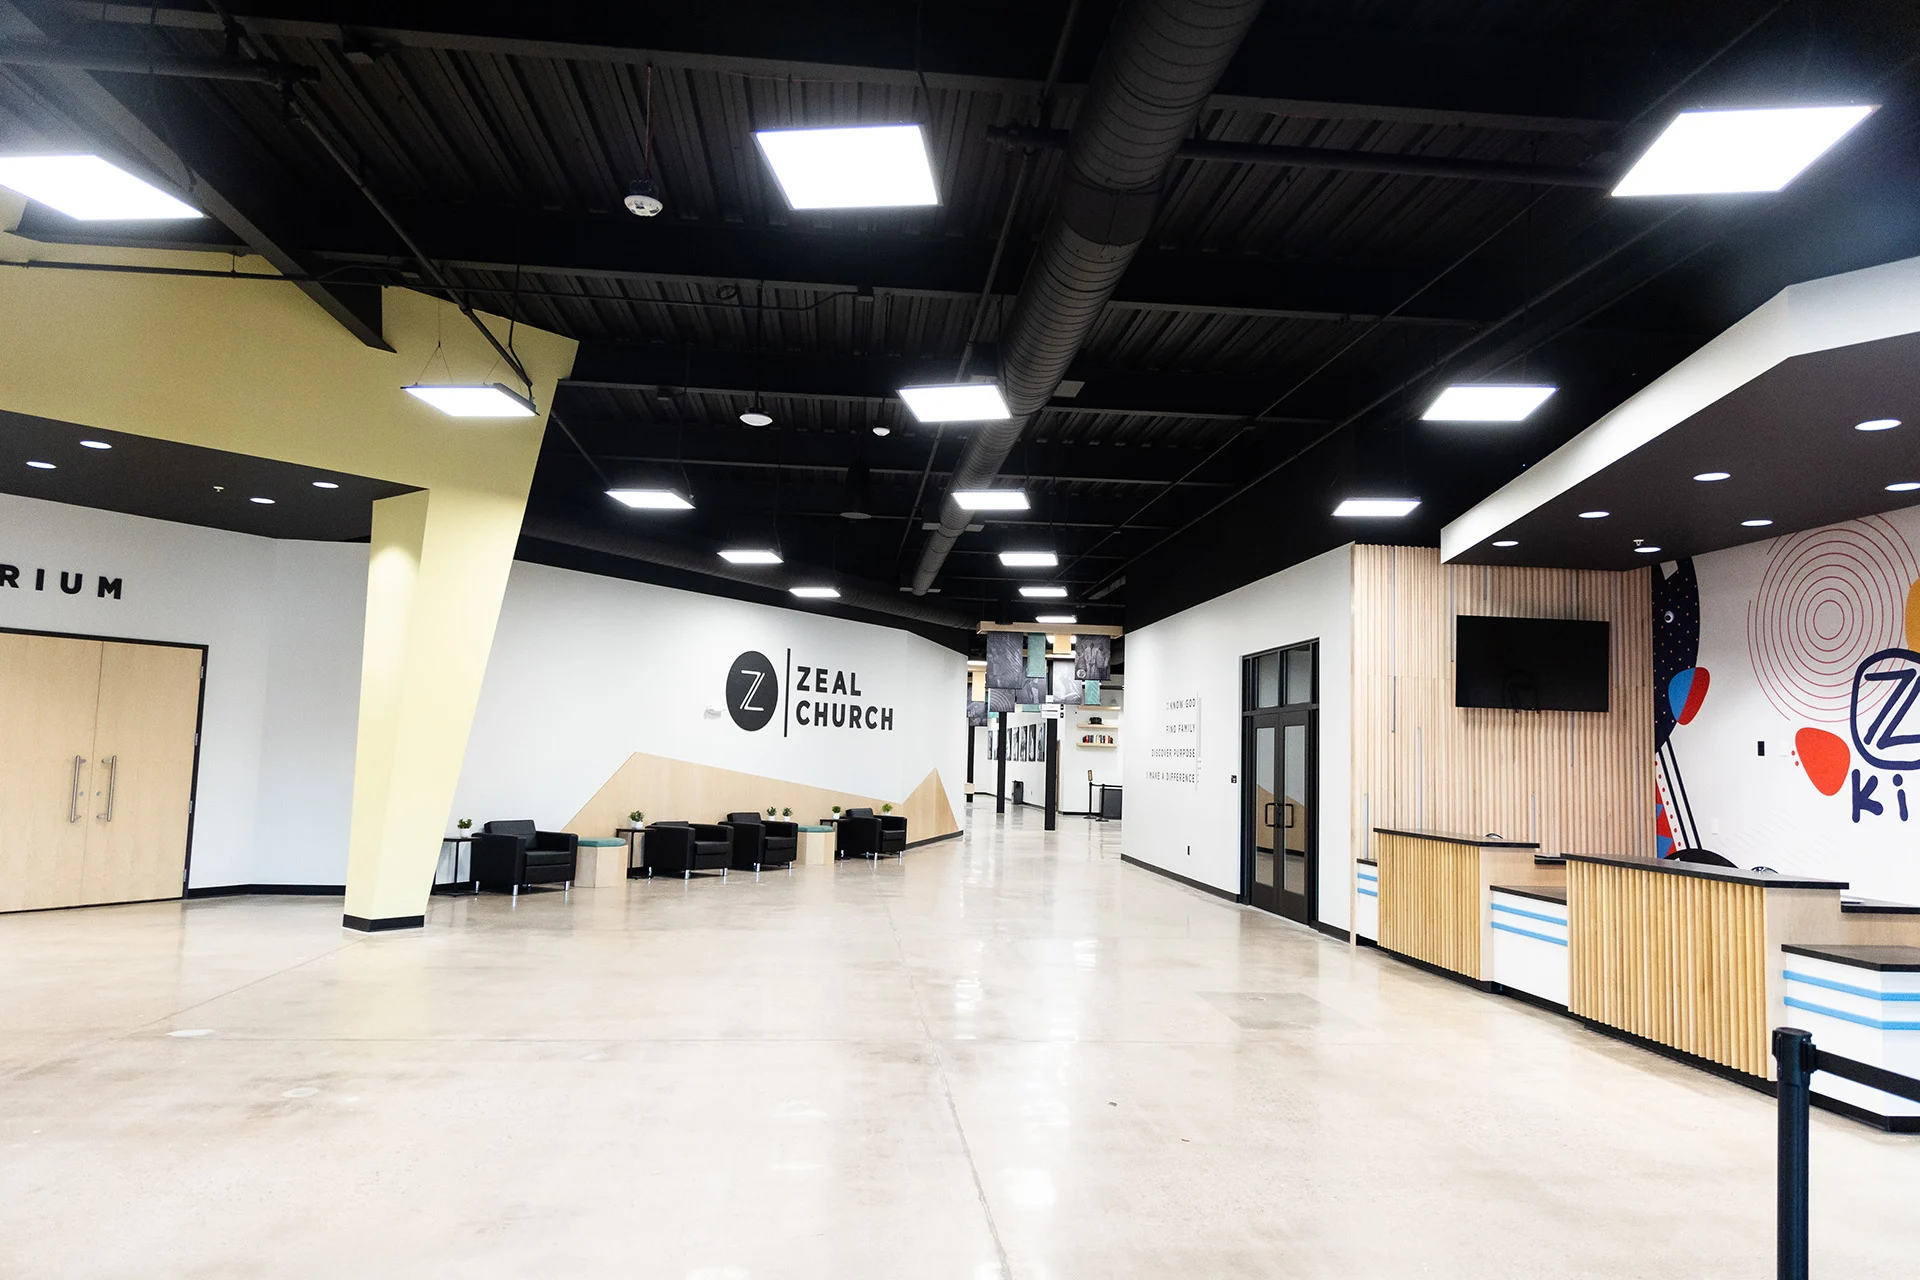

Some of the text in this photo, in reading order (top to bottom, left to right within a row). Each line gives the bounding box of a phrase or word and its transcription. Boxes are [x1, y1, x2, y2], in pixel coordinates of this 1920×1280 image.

[0, 563, 123, 600] RIUM
[796, 665, 862, 697] ZEAL
[1170, 700, 1183, 710] KNOW
[1185, 698, 1196, 708] GOD
[795, 699, 894, 731] CHURCH
[1166, 723, 1196, 734] FIND FAMILY
[1151, 748, 1195, 758] DISCOVER PURPOSE
[1149, 771, 1160, 780] MAKE
[1166, 772, 1195, 783] DIFFERENCE
